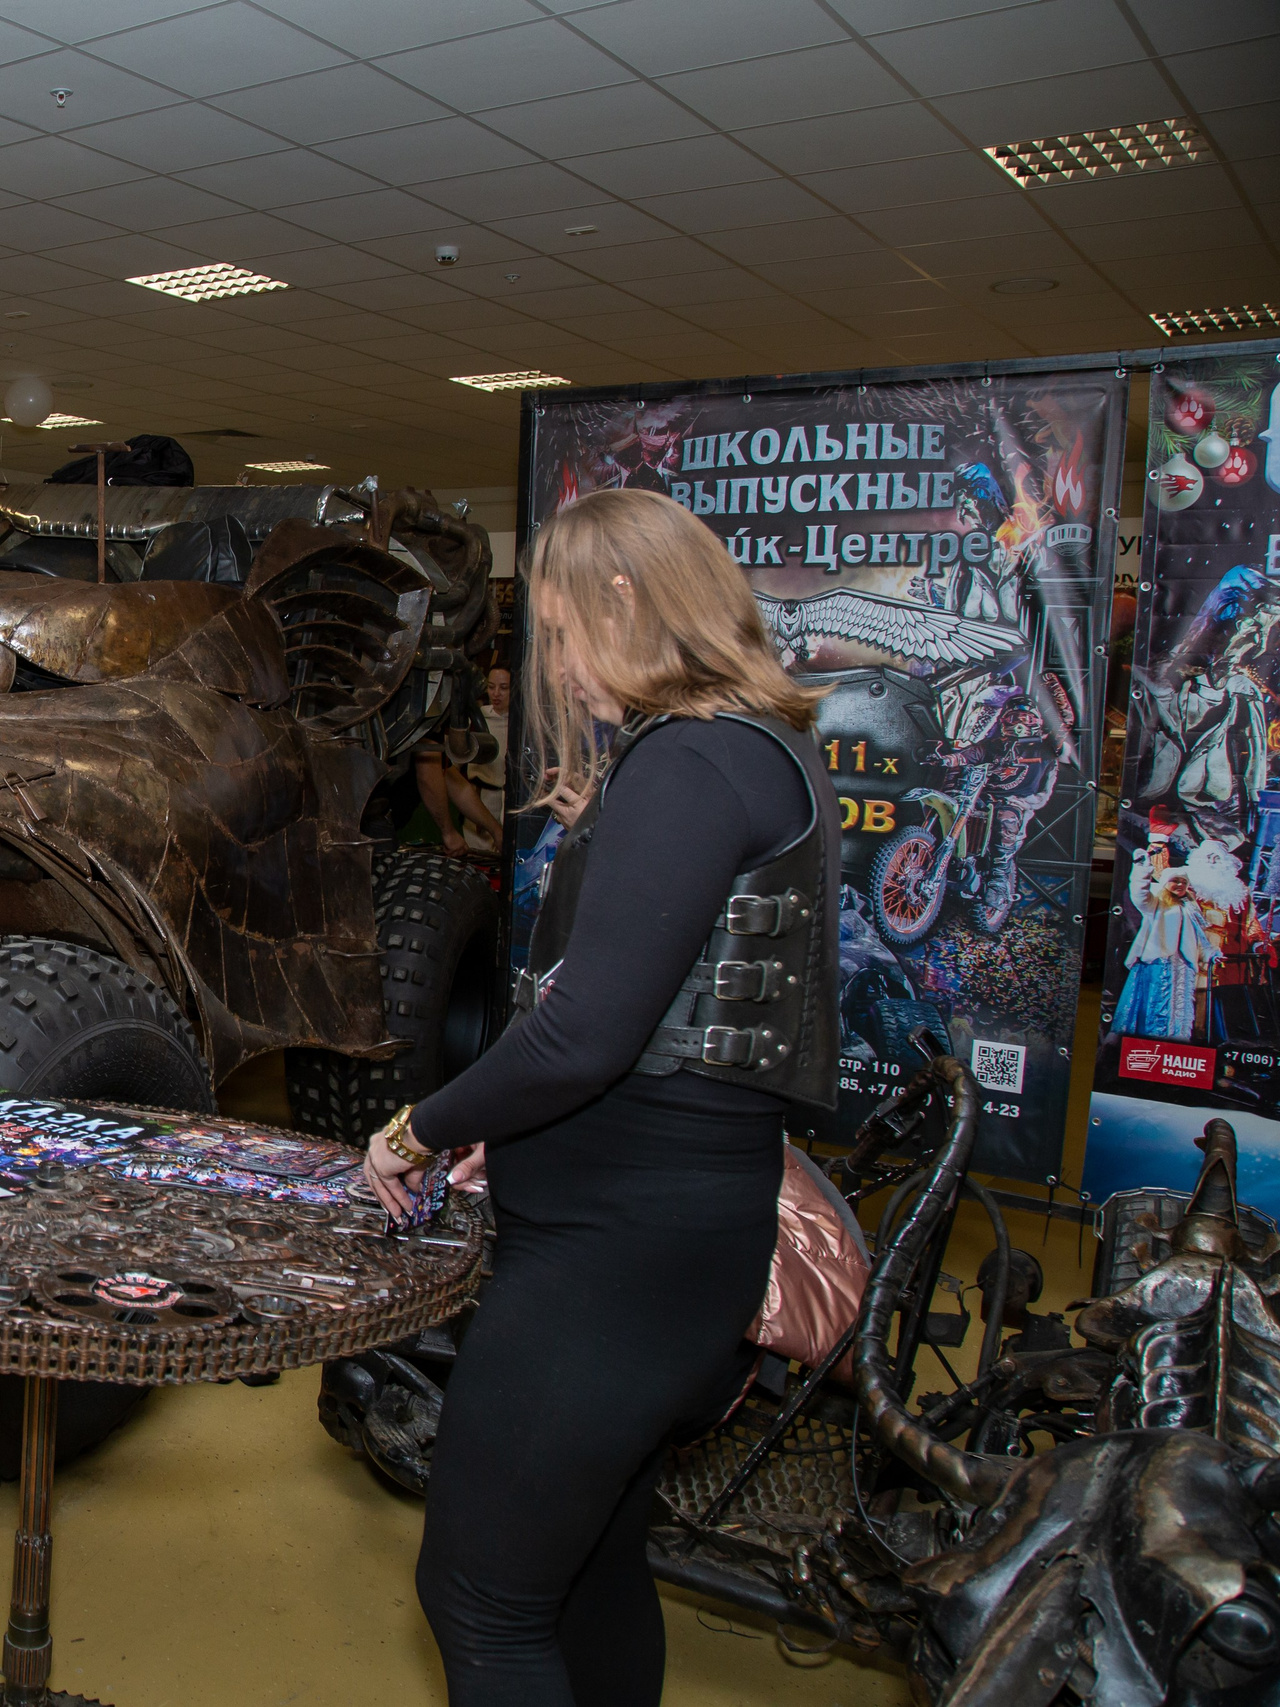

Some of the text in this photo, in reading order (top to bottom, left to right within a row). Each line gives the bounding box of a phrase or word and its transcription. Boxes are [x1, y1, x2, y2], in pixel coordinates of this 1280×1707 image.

[681, 423, 946, 472] ШКОЛЬНЫЕ
[671, 471, 957, 516] ВЫПУСКНЫЕ
[725, 524, 990, 578] йк-Центре
[838, 796, 896, 834] ОВ
[838, 1058, 901, 1077] стр. 110
[1162, 1053, 1207, 1073] НАШЕ
[1224, 1050, 1239, 1062] +7
[1241, 1052, 1274, 1067] (906)
[1161, 1068, 1197, 1080] РАДИО
[836, 1076, 863, 1094] 85,
[867, 1082, 888, 1096] +7
